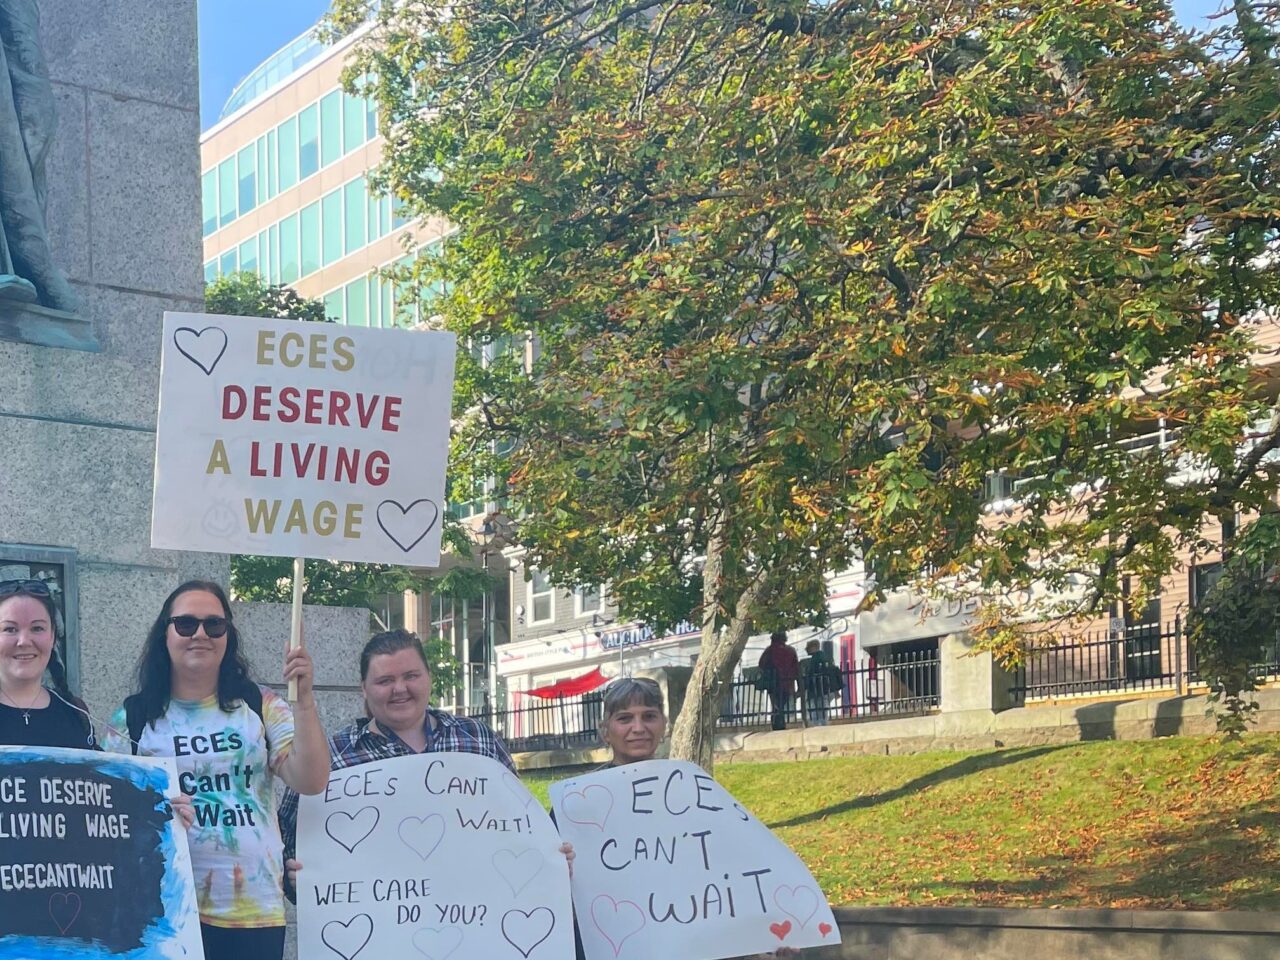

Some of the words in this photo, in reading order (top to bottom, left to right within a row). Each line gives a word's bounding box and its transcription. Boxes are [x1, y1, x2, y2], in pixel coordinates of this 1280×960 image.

[256, 330, 355, 372] ECES
[222, 384, 402, 432] DESERVE
[206, 439, 231, 475] A
[250, 441, 390, 486] LIVING
[244, 498, 364, 539] WAGE
[173, 731, 243, 757] ECEs
[40, 777, 114, 809] DESERVE
[179, 764, 254, 796] Can't
[86, 813, 131, 840] WAGE
[195, 803, 256, 828] Wait
[600, 830, 712, 871] CAN'T
[314, 880, 364, 906] WEE
[373, 878, 431, 902] CARE
[397, 904, 421, 924] DO
[435, 904, 488, 926] YOU?
